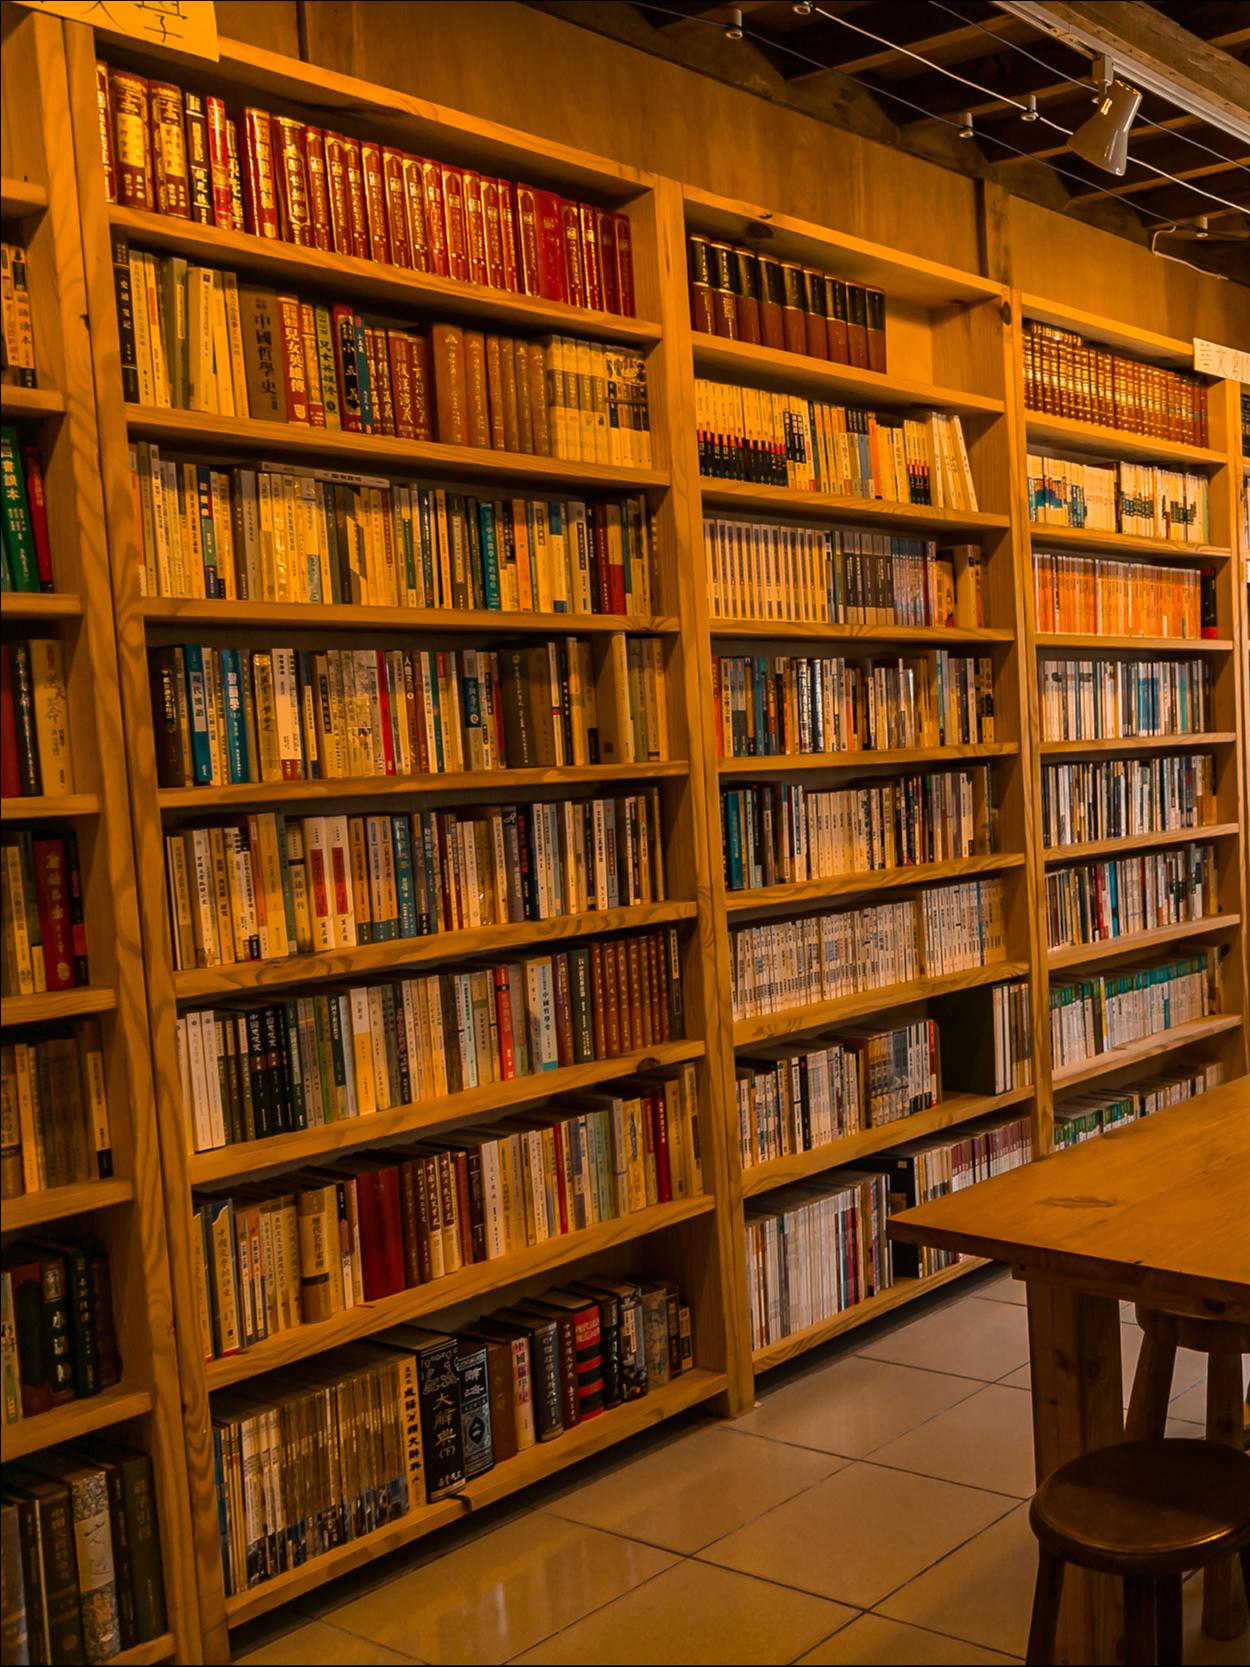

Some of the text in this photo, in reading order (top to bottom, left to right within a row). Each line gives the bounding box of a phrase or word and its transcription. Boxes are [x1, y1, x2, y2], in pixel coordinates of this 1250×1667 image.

[254, 313, 277, 395] 中國哲學史
[285, 326, 306, 393] 兒女英雄傳
